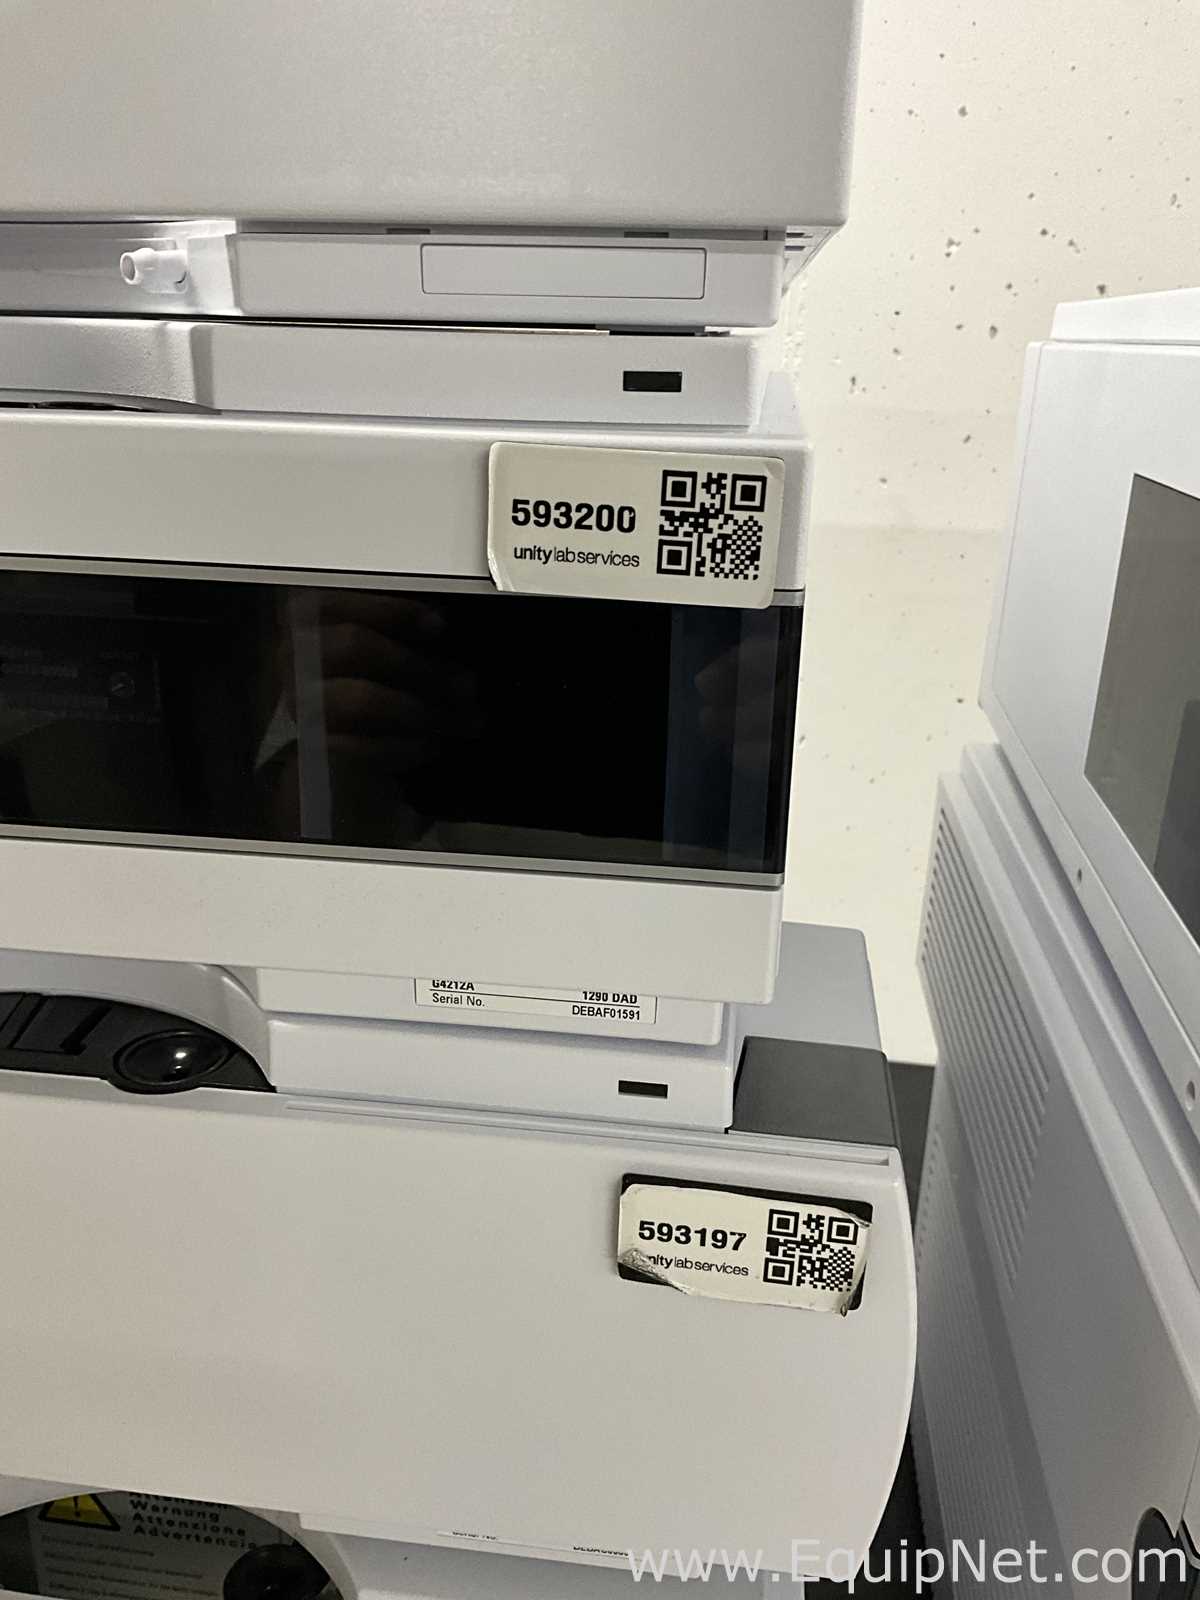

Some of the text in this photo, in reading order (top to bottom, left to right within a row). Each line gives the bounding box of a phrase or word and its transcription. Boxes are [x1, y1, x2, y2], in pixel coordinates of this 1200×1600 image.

[511, 498, 636, 533] 593200
[432, 992, 640, 1020] Serial No. DEBAF01591
[582, 990, 609, 1002] 1290
[612, 992, 637, 1004] DAD
[638, 1220, 747, 1251] 593197
[130, 1499, 219, 1523] Warnung
